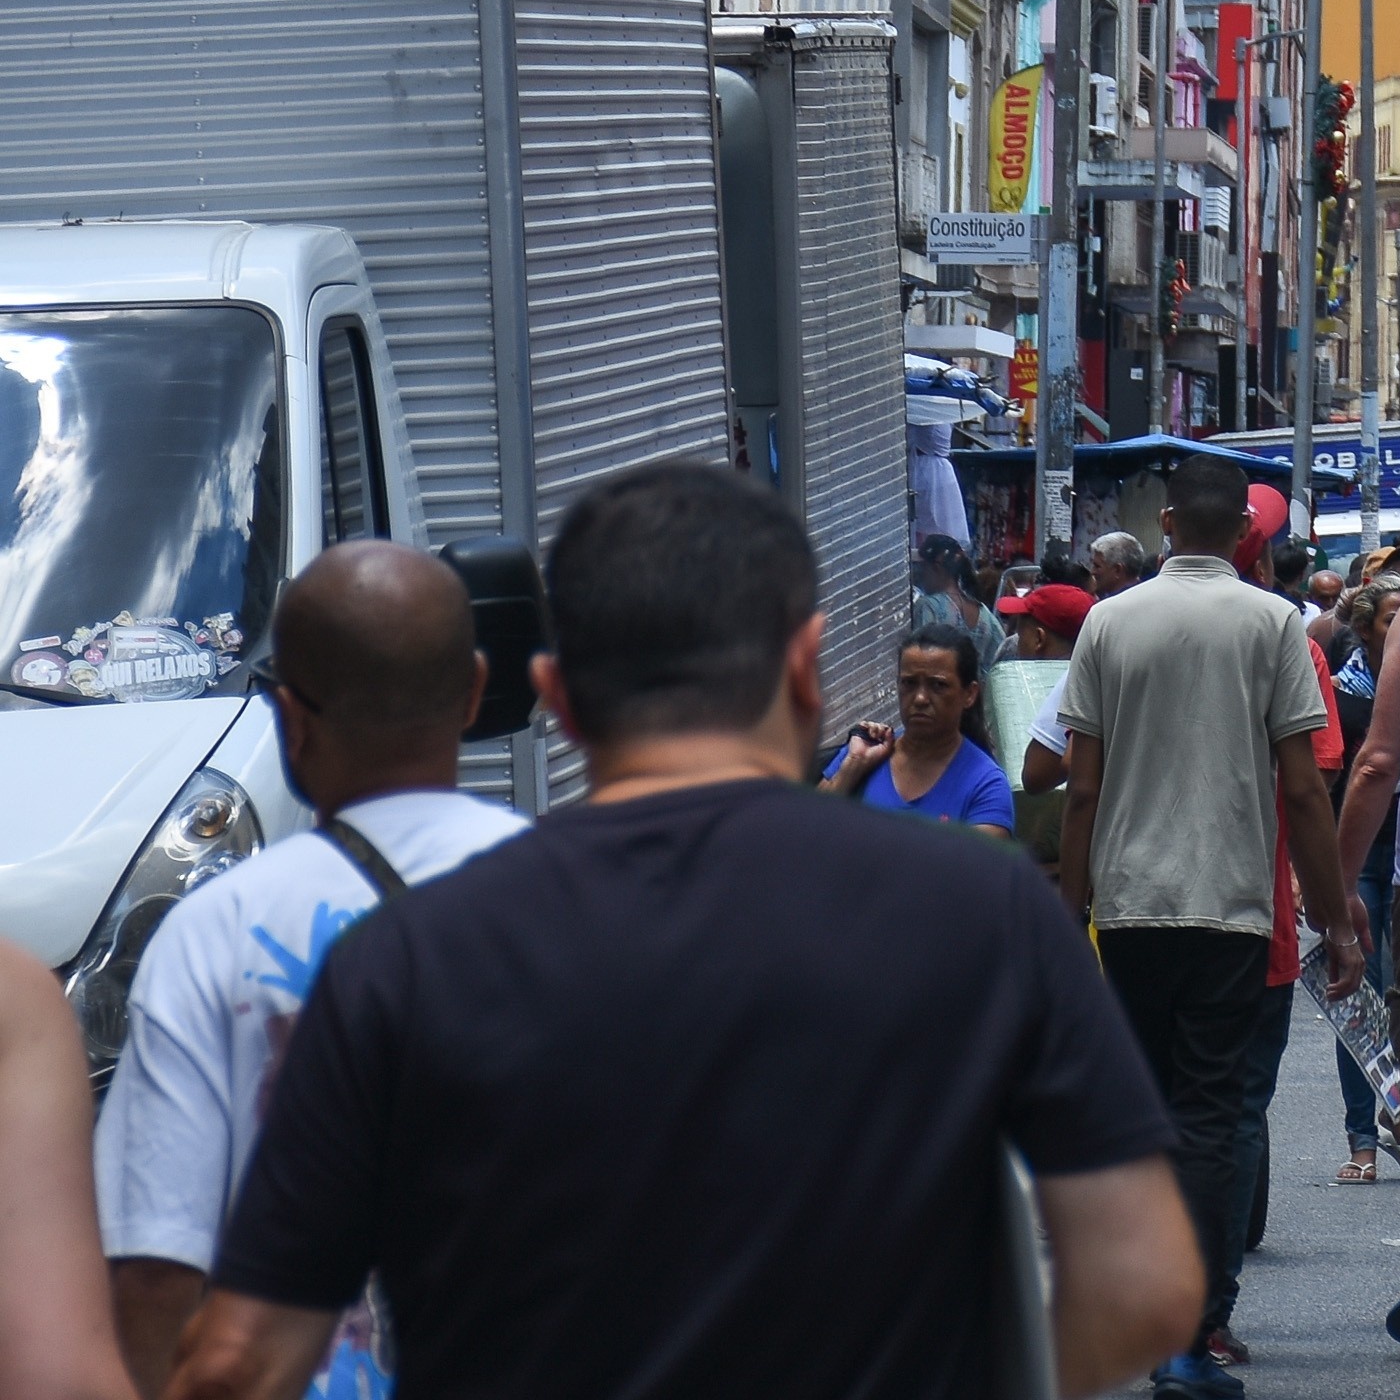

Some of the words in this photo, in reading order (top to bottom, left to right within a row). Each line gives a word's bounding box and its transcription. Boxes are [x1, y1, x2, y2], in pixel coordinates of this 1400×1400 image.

[997, 83, 1031, 180] ALMOÇO
[930, 217, 1025, 241] Constituição
[134, 653, 211, 683] RELAXOS
